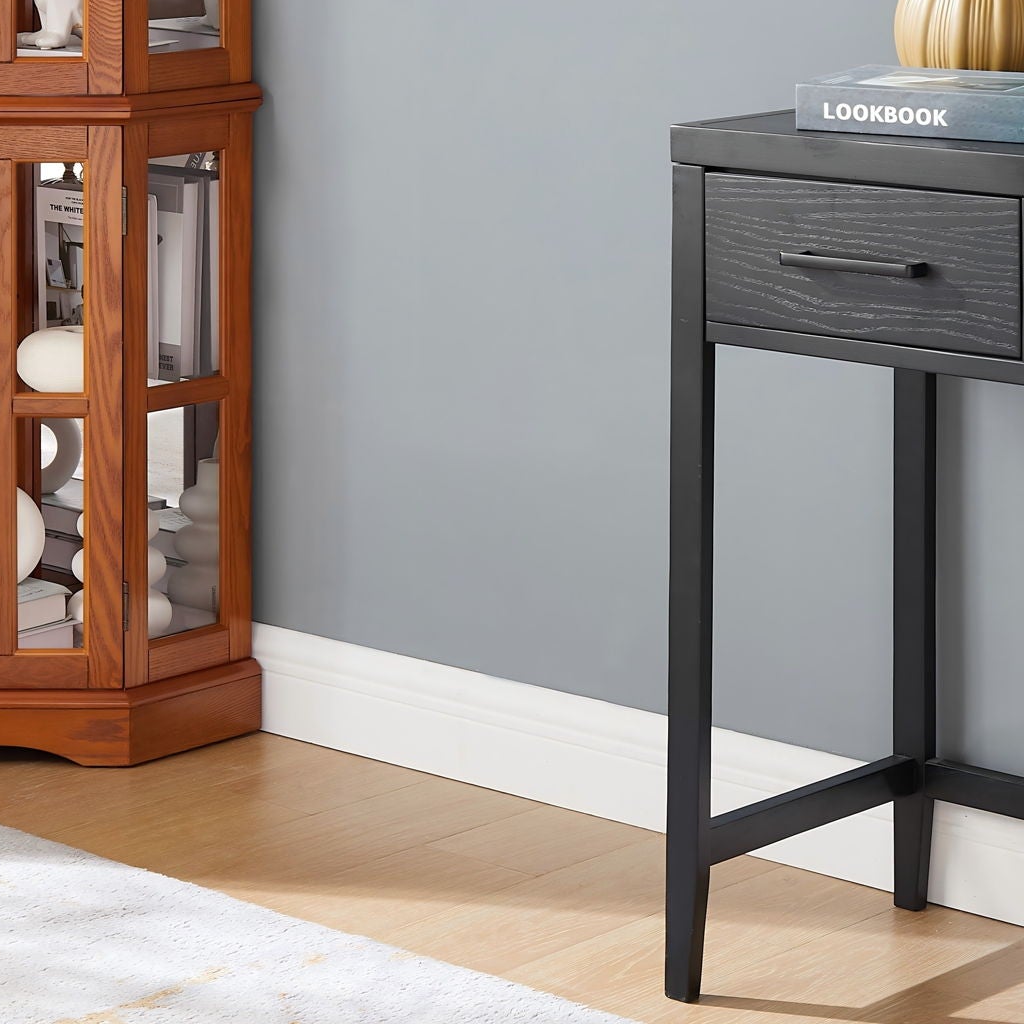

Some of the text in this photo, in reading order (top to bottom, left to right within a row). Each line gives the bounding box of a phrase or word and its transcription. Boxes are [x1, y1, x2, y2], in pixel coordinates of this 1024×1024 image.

[823, 102, 948, 127] LOOKBOOK
[49, 203, 64, 212] THE
[63, 205, 84, 215] WHITE
